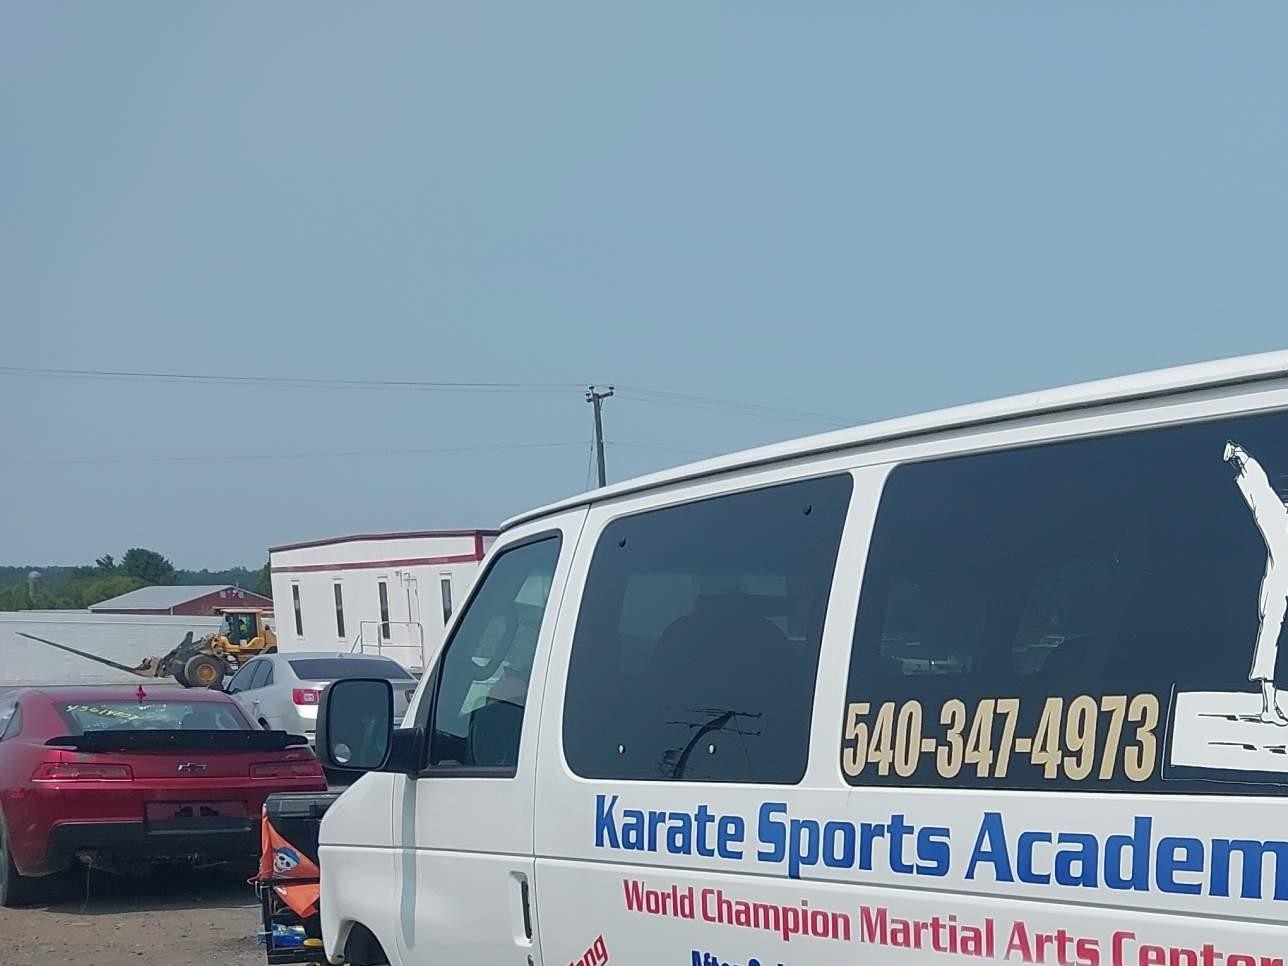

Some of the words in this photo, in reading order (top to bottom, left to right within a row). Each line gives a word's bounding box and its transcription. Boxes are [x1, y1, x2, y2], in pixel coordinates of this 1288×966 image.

[843, 693, 1160, 783] 540-347-4973
[594, 794, 745, 861] Karate
[757, 802, 951, 880] Sports
[623, 879, 695, 920] World
[700, 888, 852, 942] Champion
[860, 905, 994, 959] Martial
